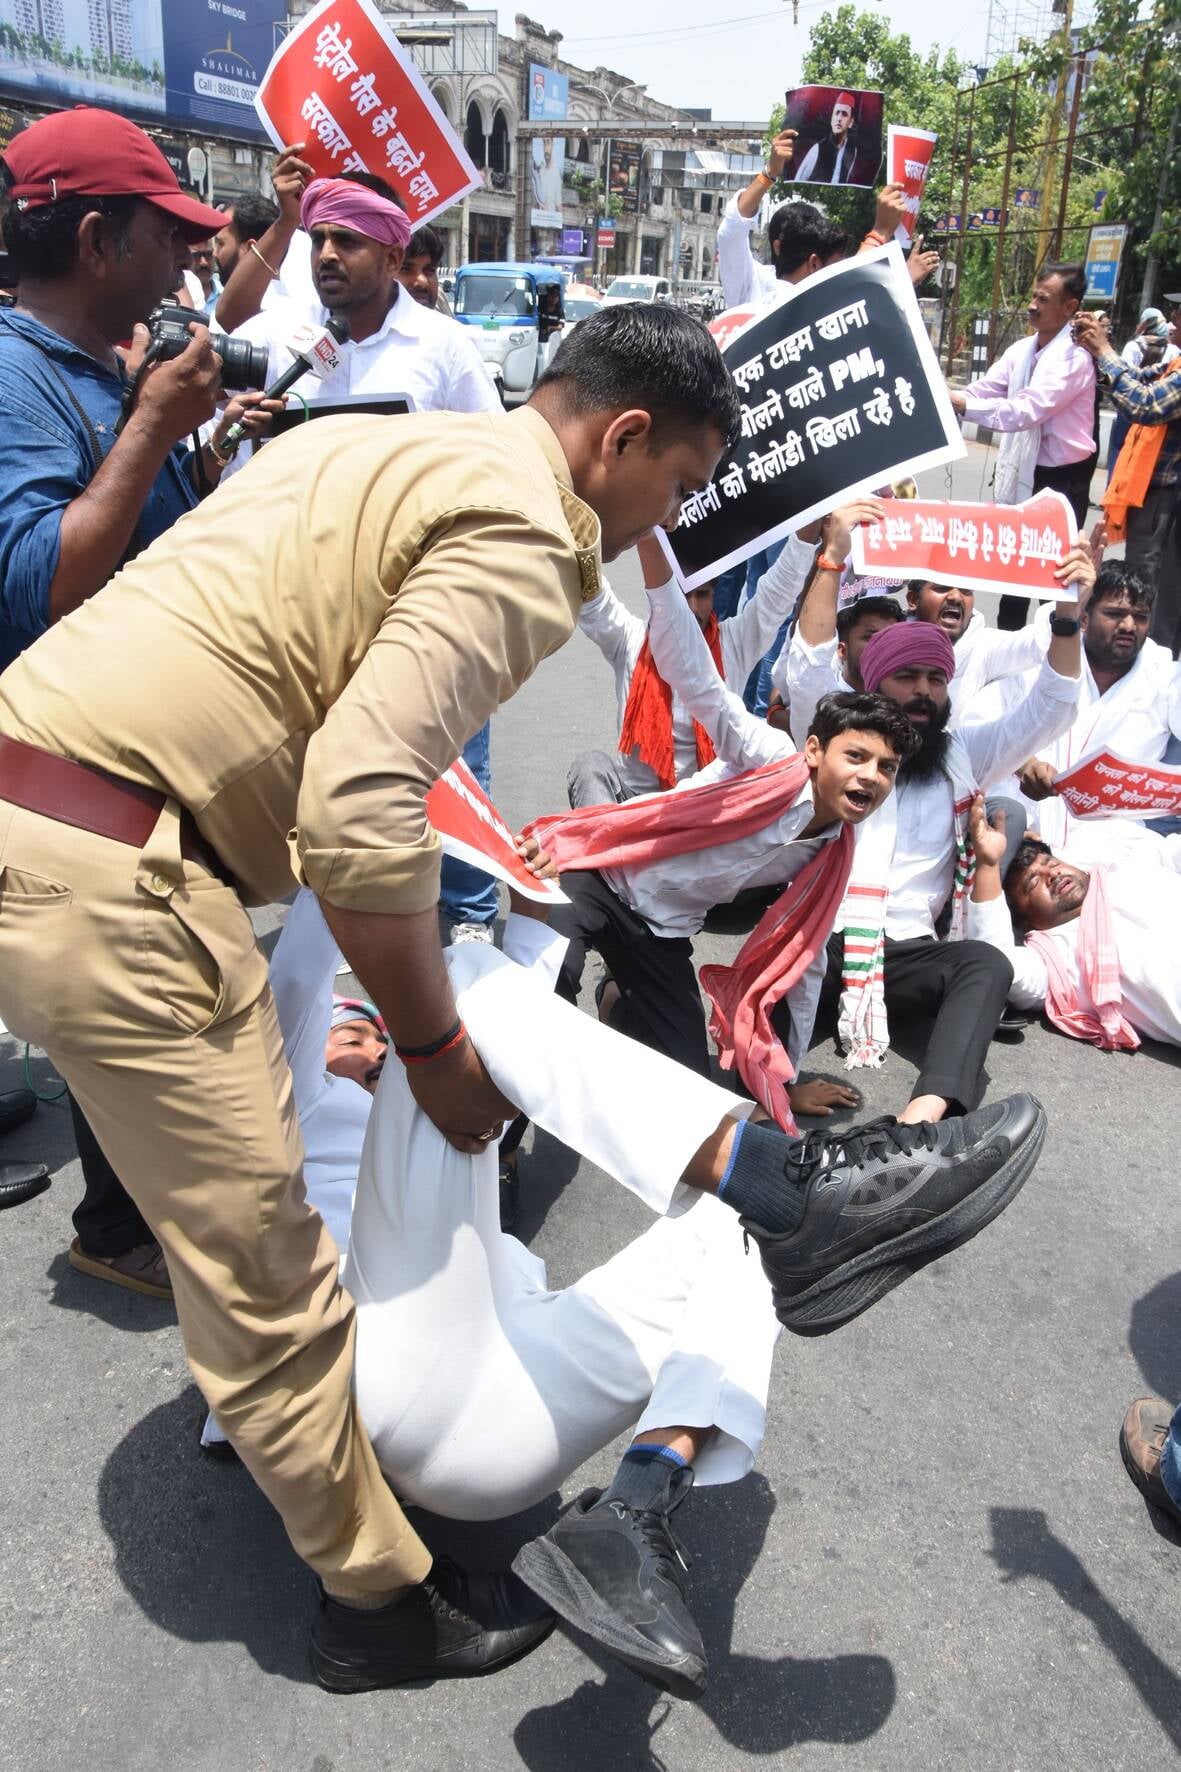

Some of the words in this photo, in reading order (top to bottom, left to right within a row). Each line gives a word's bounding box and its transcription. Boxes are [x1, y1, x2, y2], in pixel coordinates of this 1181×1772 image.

[208, 0, 221, 12] SKY
[222, 4, 247, 21] BRIDGE
[198, 78, 212, 92] Call
[218, 83, 239, 98] 88801
[202, 58, 257, 80] SHALIMAR
[301, 91, 352, 159] सरकार
[313, 21, 359, 82] पेट्रोल
[350, 72, 383, 116] गैस
[371, 106, 398, 138] के
[385, 131, 426, 178] बढ़ते
[408, 170, 440, 213] दाम,
[328, 355, 339, 368] 24
[732, 354, 764, 393] एक
[766, 326, 814, 371] टाइम
[815, 299, 869, 341] खाना
[785, 366, 826, 412] वाले
[828, 346, 885, 390] PM,
[720, 463, 747, 500] को
[747, 430, 806, 484] मेलोडी
[806, 407, 862, 455] खिला
[863, 385, 893, 426] रहे
[885, 516, 912, 550] मजे
[948, 518, 978, 561] कैसी
[981, 522, 993, 562] ये
[997, 525, 1016, 565] की
[1018, 526, 1062, 567] महंगाई
[1094, 762, 1128, 780] जनता
[1127, 772, 1147, 784] को
[1144, 778, 1169, 792] एक
[1102, 783, 1122, 796] को
[1120, 790, 1153, 804] बोलने
[1151, 796, 1177, 809] वाले
[1062, 786, 1099, 809] मेलोनी
